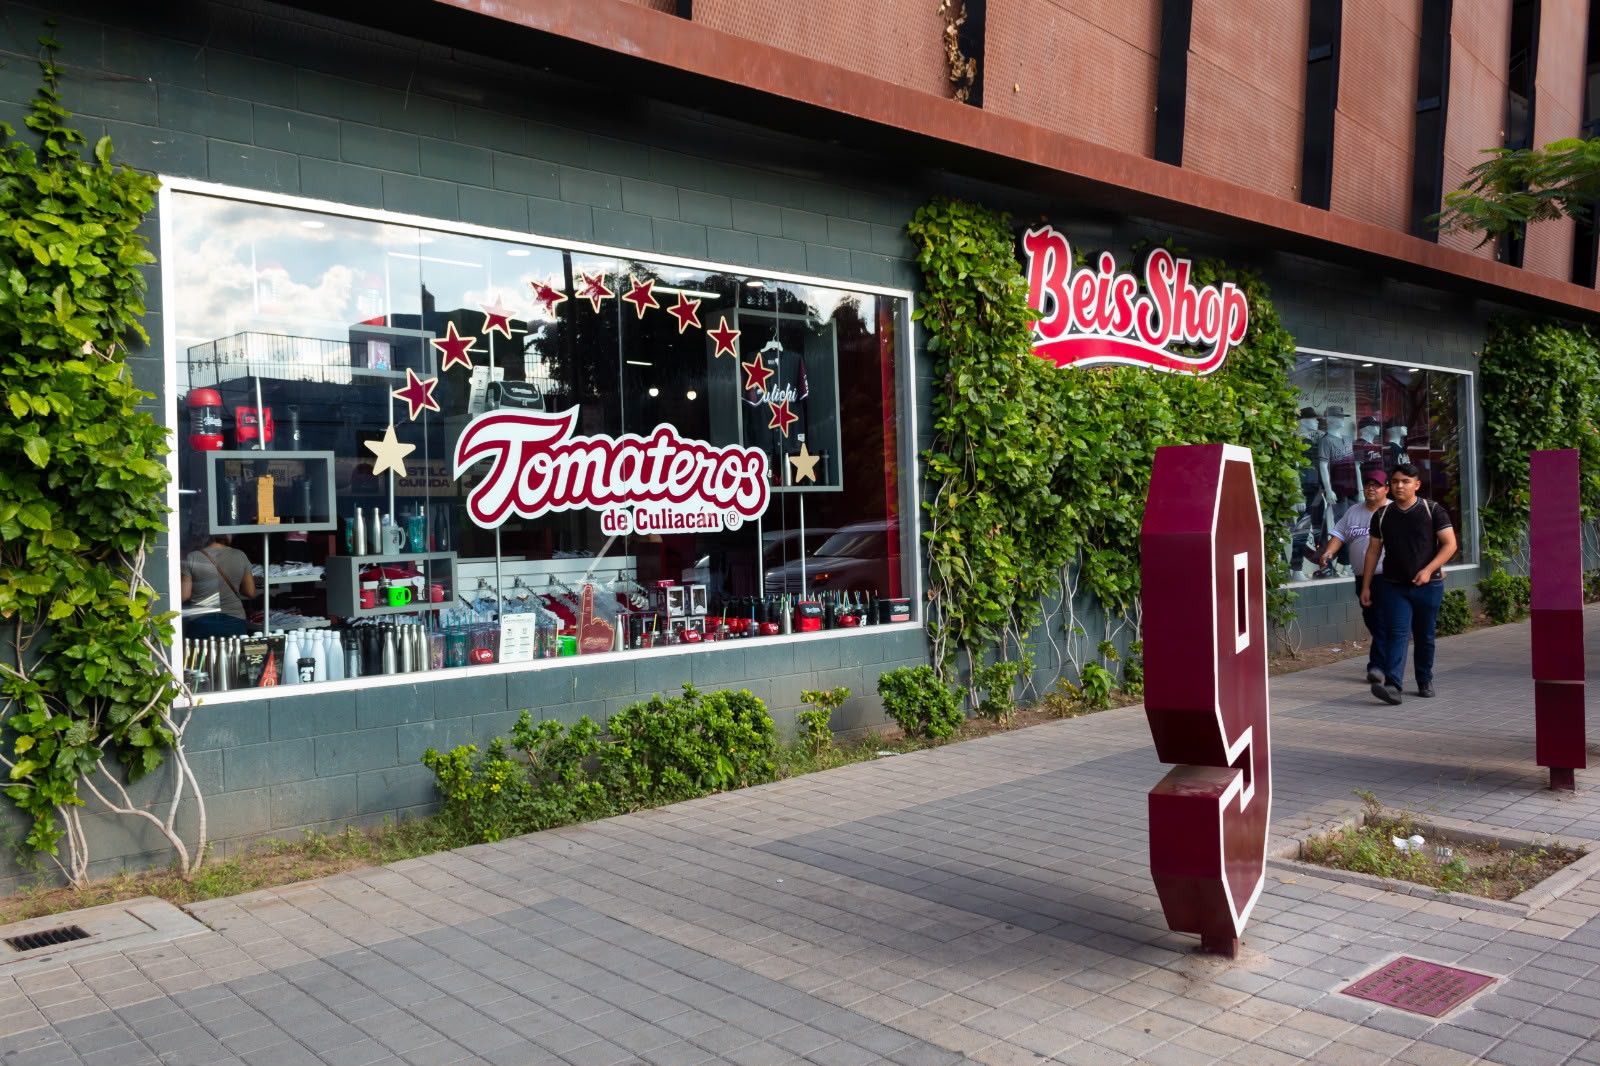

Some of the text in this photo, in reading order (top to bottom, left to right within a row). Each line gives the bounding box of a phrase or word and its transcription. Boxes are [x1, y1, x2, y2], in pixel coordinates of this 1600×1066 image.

[1025, 226, 1248, 368] Beis Shop
[456, 410, 769, 525] Tomateros
[603, 509, 628, 531] de
[635, 506, 719, 530] Culiacán
